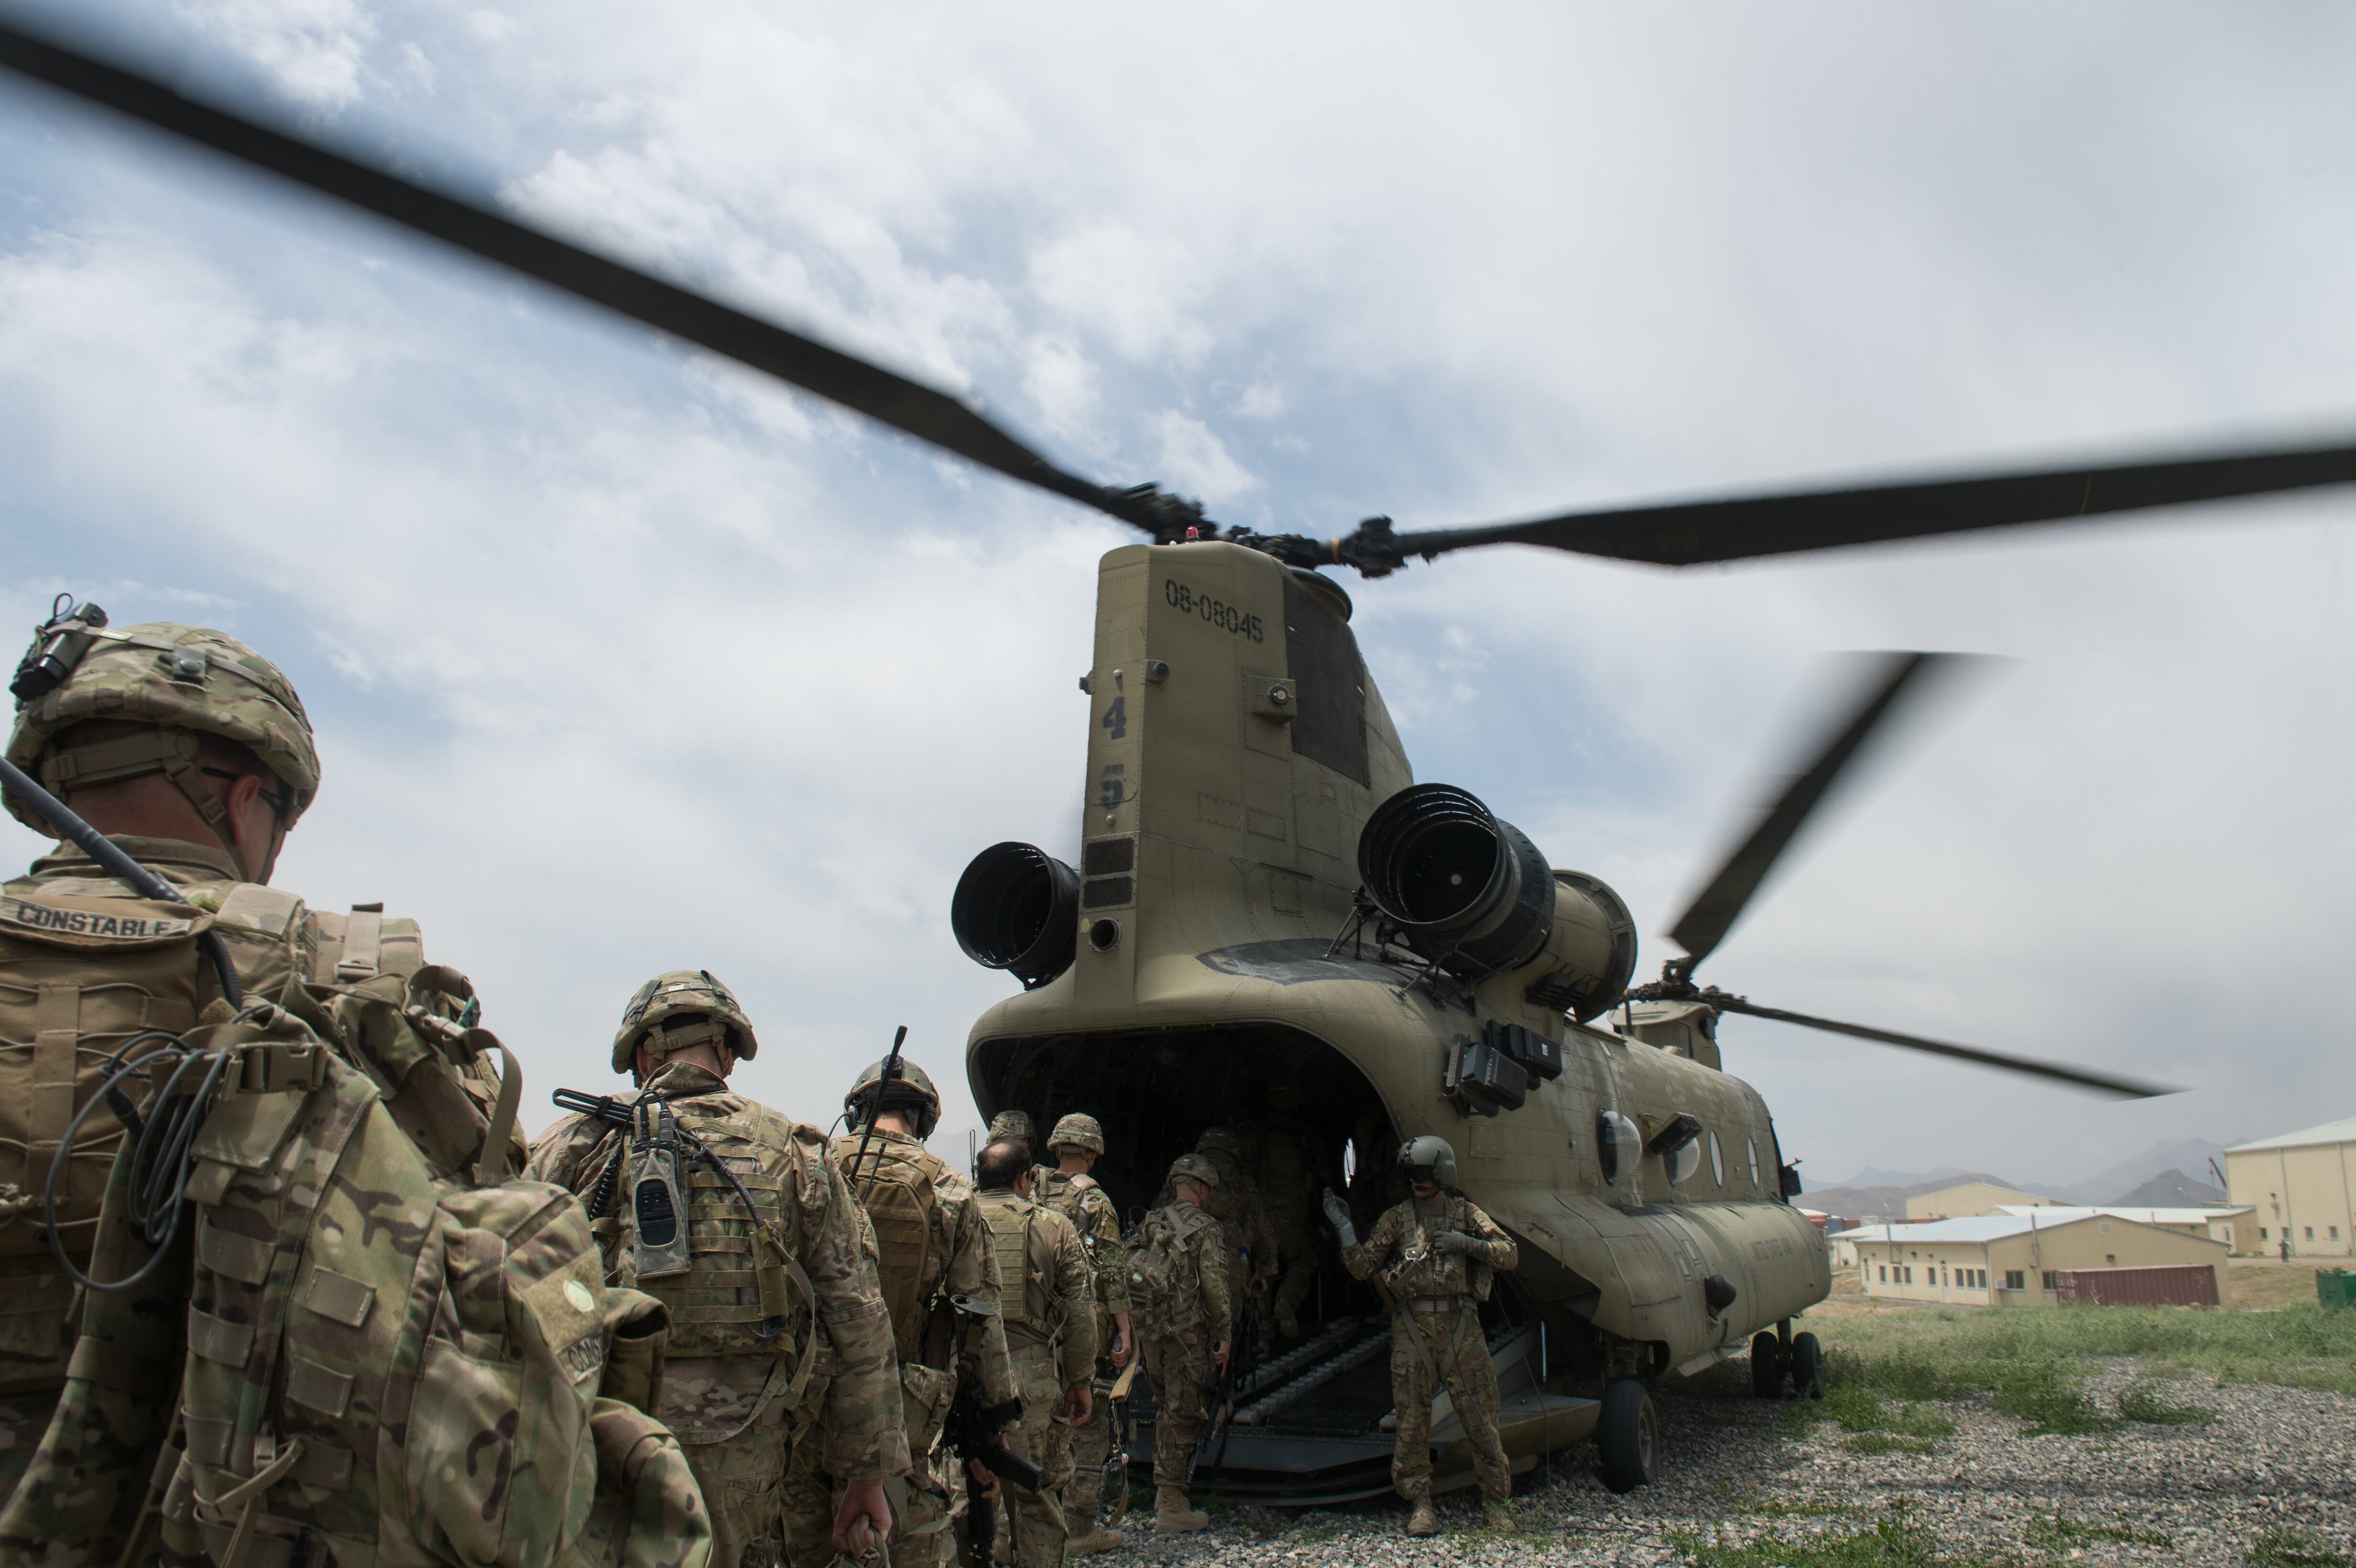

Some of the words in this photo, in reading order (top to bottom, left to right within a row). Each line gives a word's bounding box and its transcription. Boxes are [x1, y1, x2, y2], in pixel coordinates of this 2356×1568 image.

[1166, 579, 1263, 643] 08-08045
[1102, 696, 1127, 740] 4
[17, 904, 171, 937] CONSTABLE
